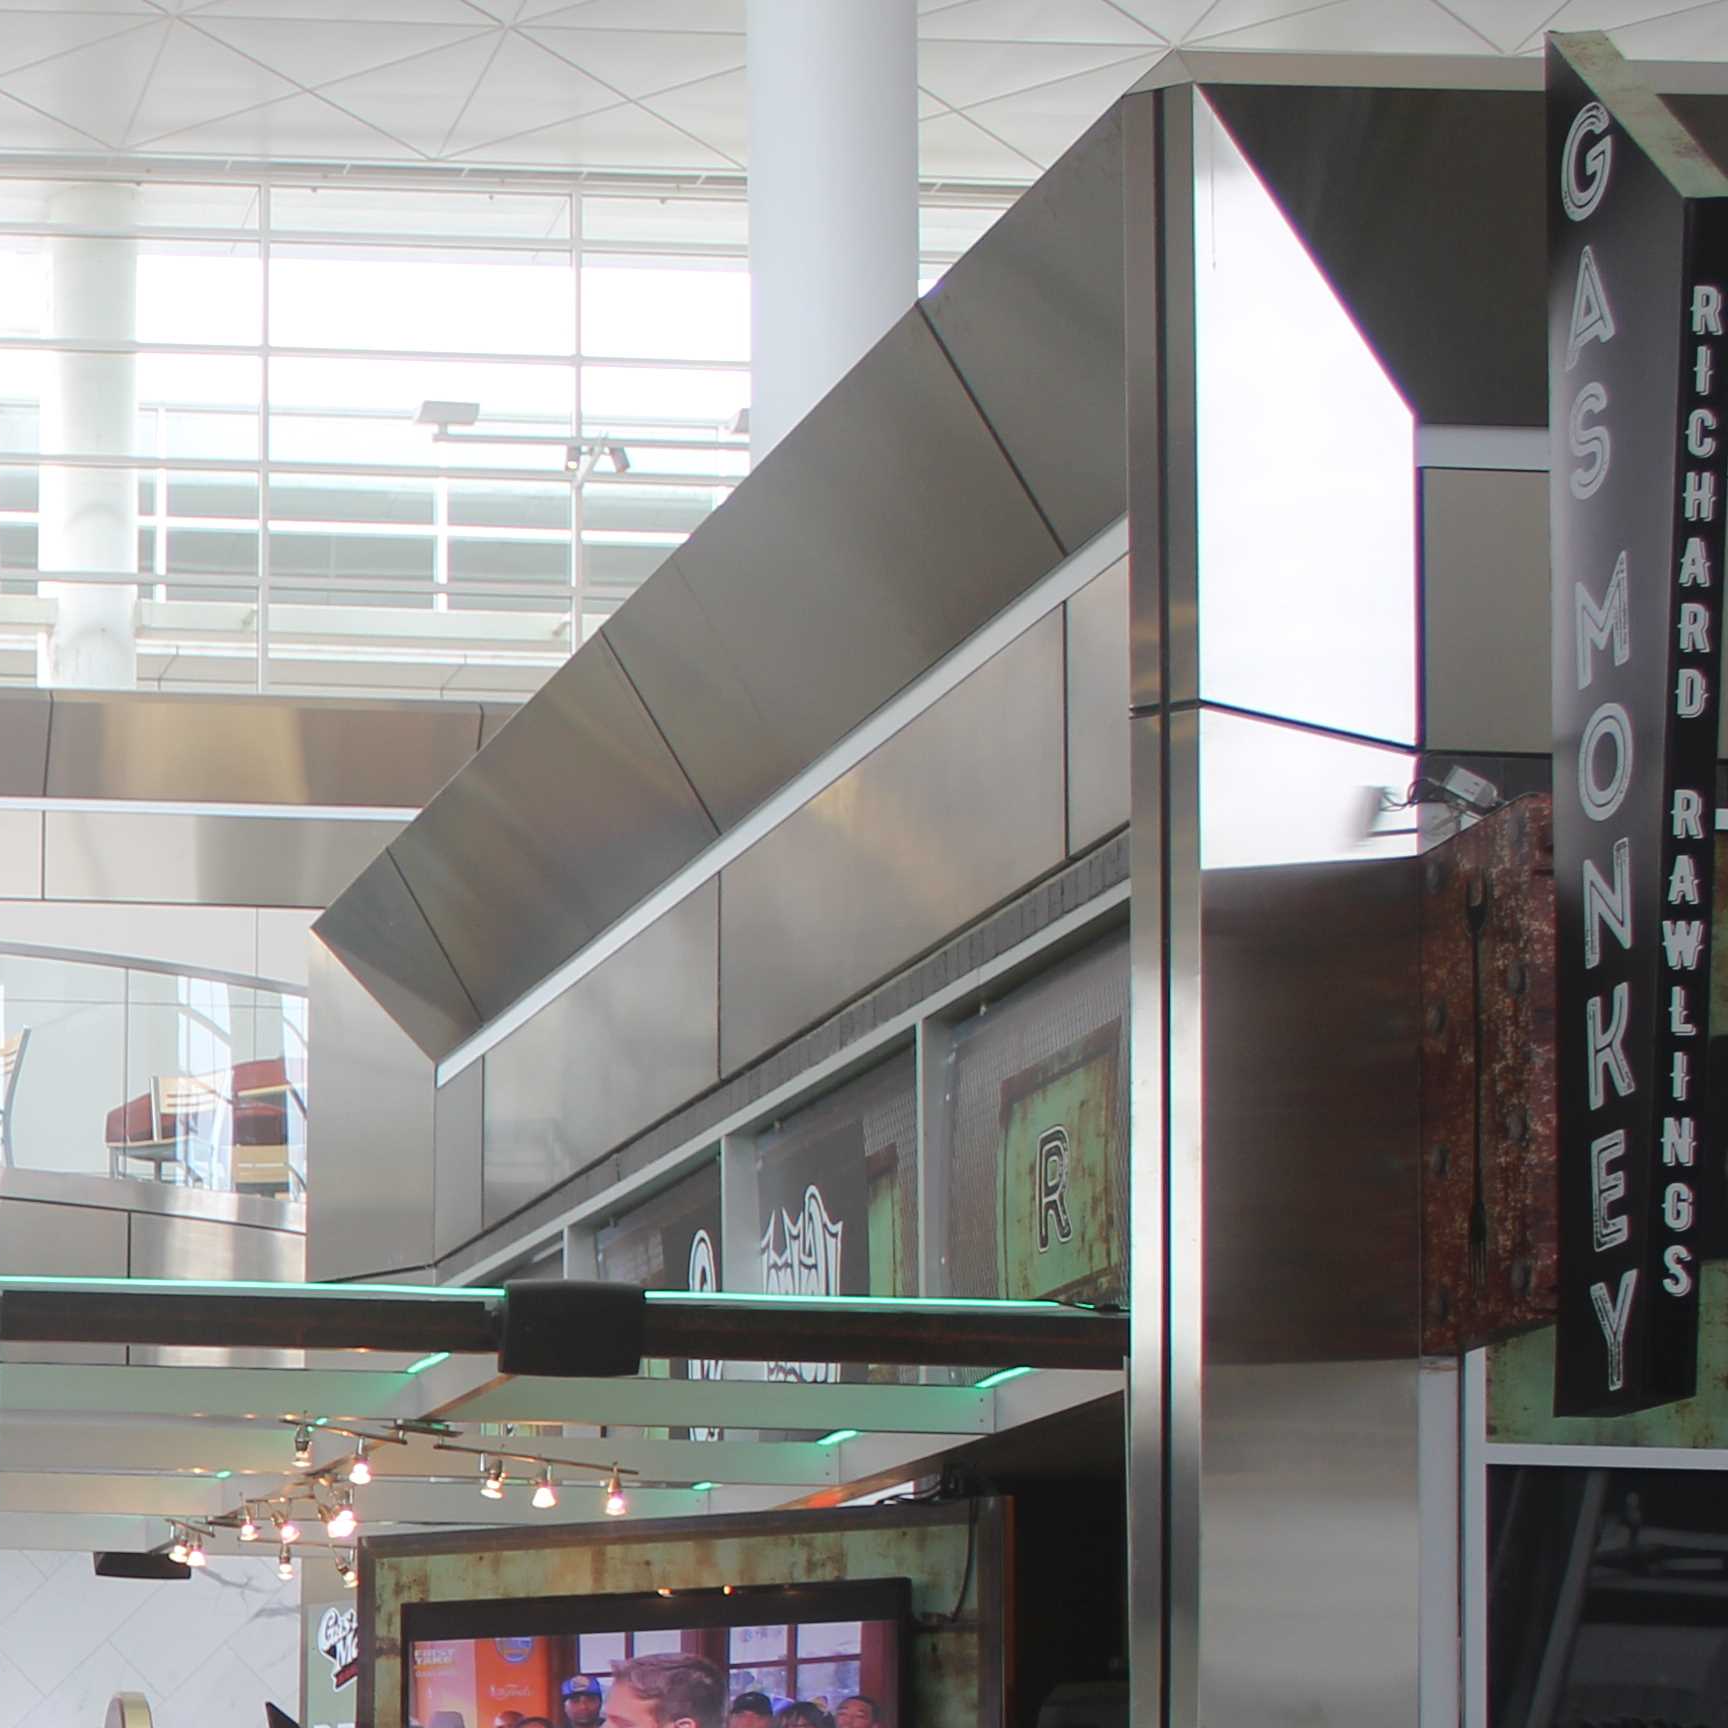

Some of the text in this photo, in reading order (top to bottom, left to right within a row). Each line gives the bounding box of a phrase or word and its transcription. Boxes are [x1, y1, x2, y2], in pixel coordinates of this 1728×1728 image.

[1036, 1122, 1073, 1254] R
[1559, 100, 1638, 1391] GAS MONKEY
[1661, 284, 1722, 1299] RICHARD RAWLINGS
